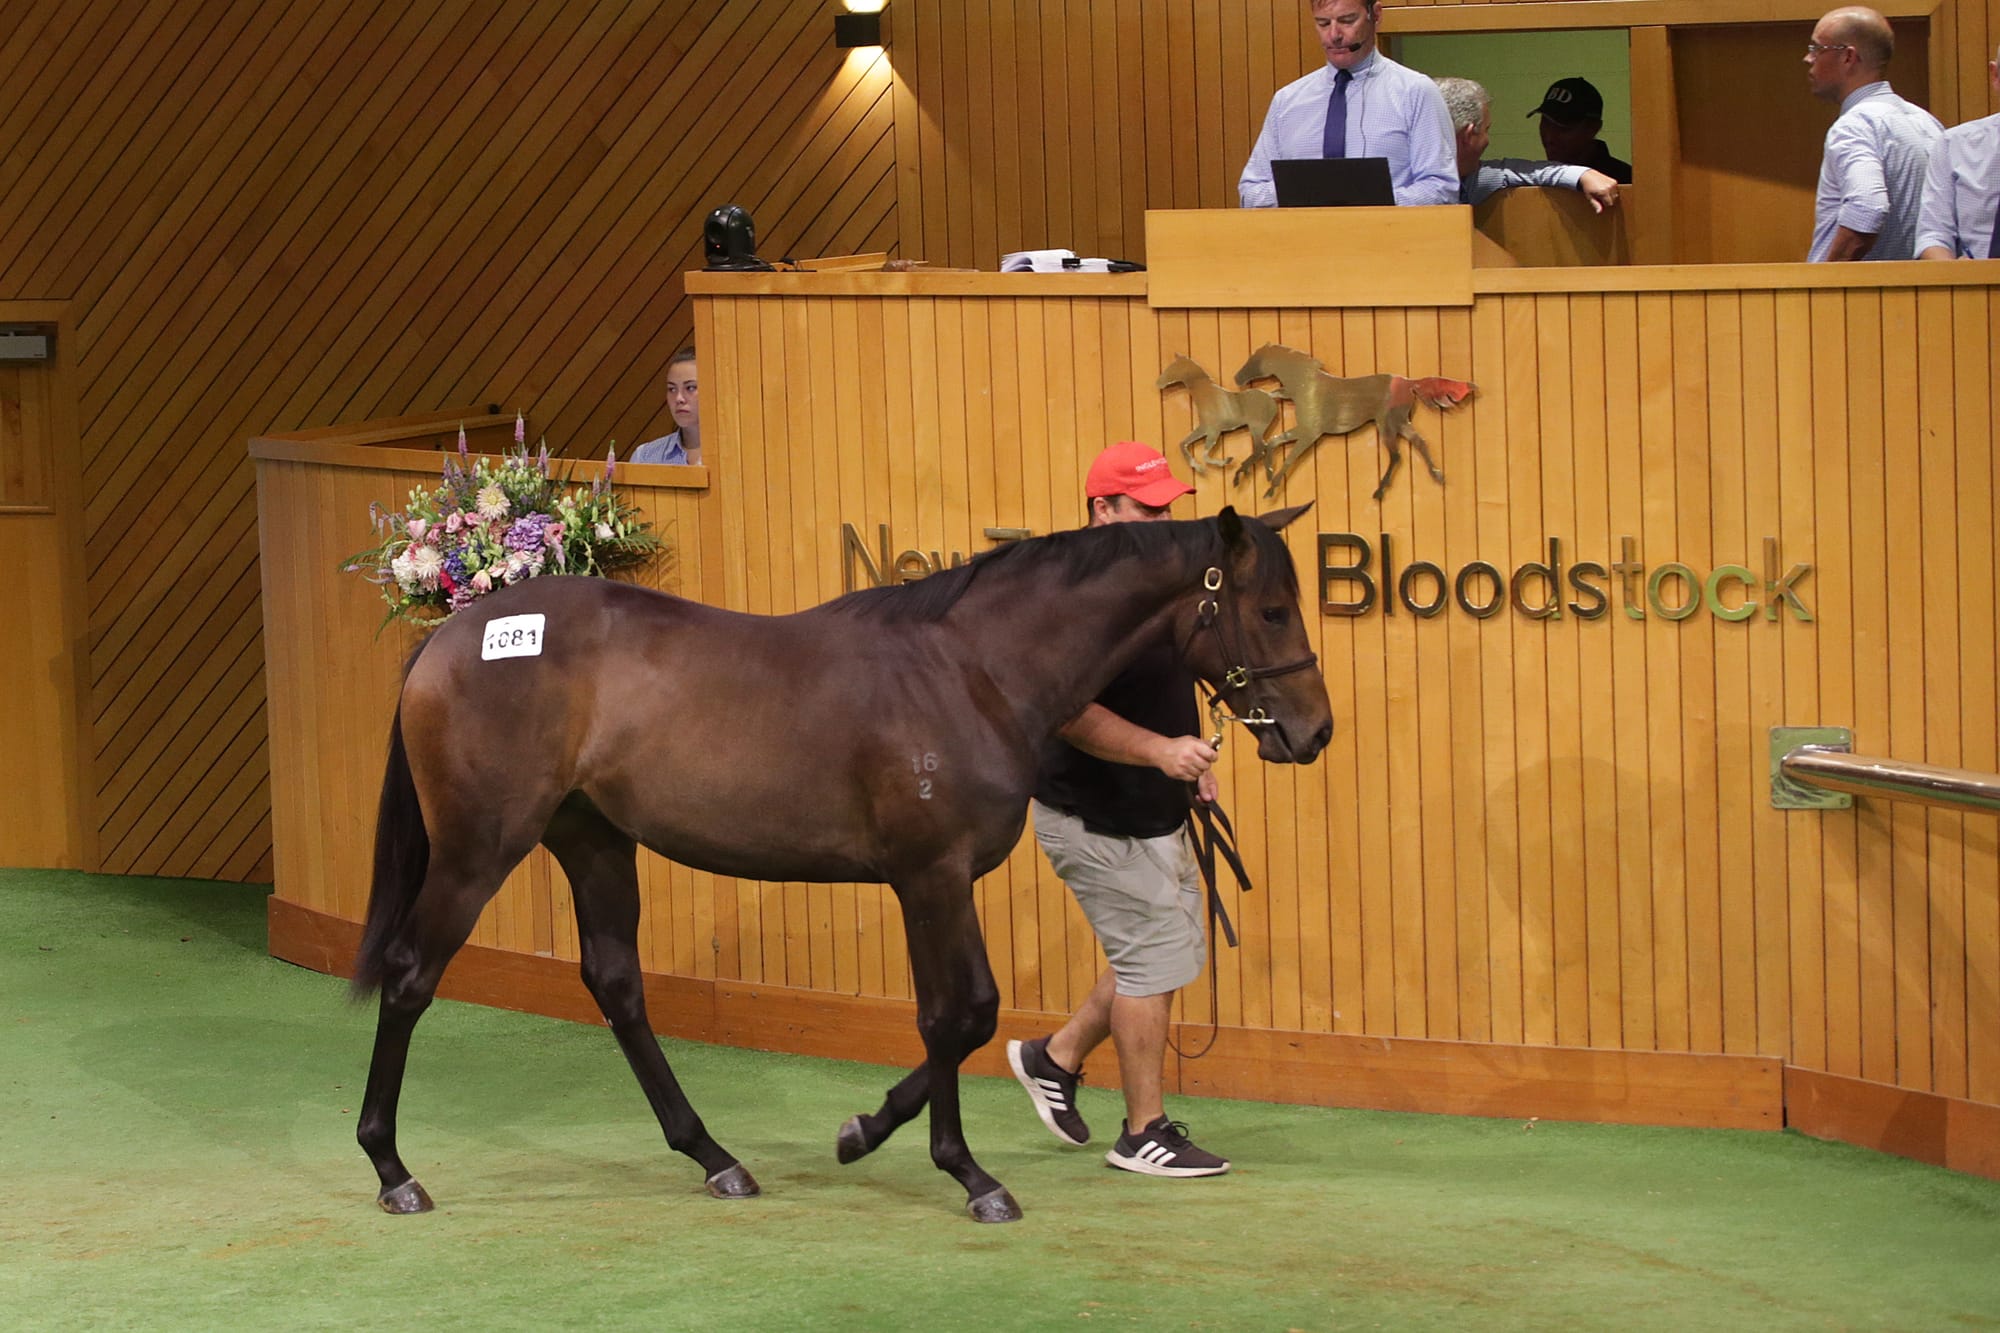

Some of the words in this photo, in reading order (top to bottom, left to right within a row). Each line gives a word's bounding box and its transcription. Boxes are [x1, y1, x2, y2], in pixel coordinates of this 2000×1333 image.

[1318, 532, 1815, 621] Bloodstock
[912, 752, 938, 774] 16
[919, 779, 932, 800] 2
